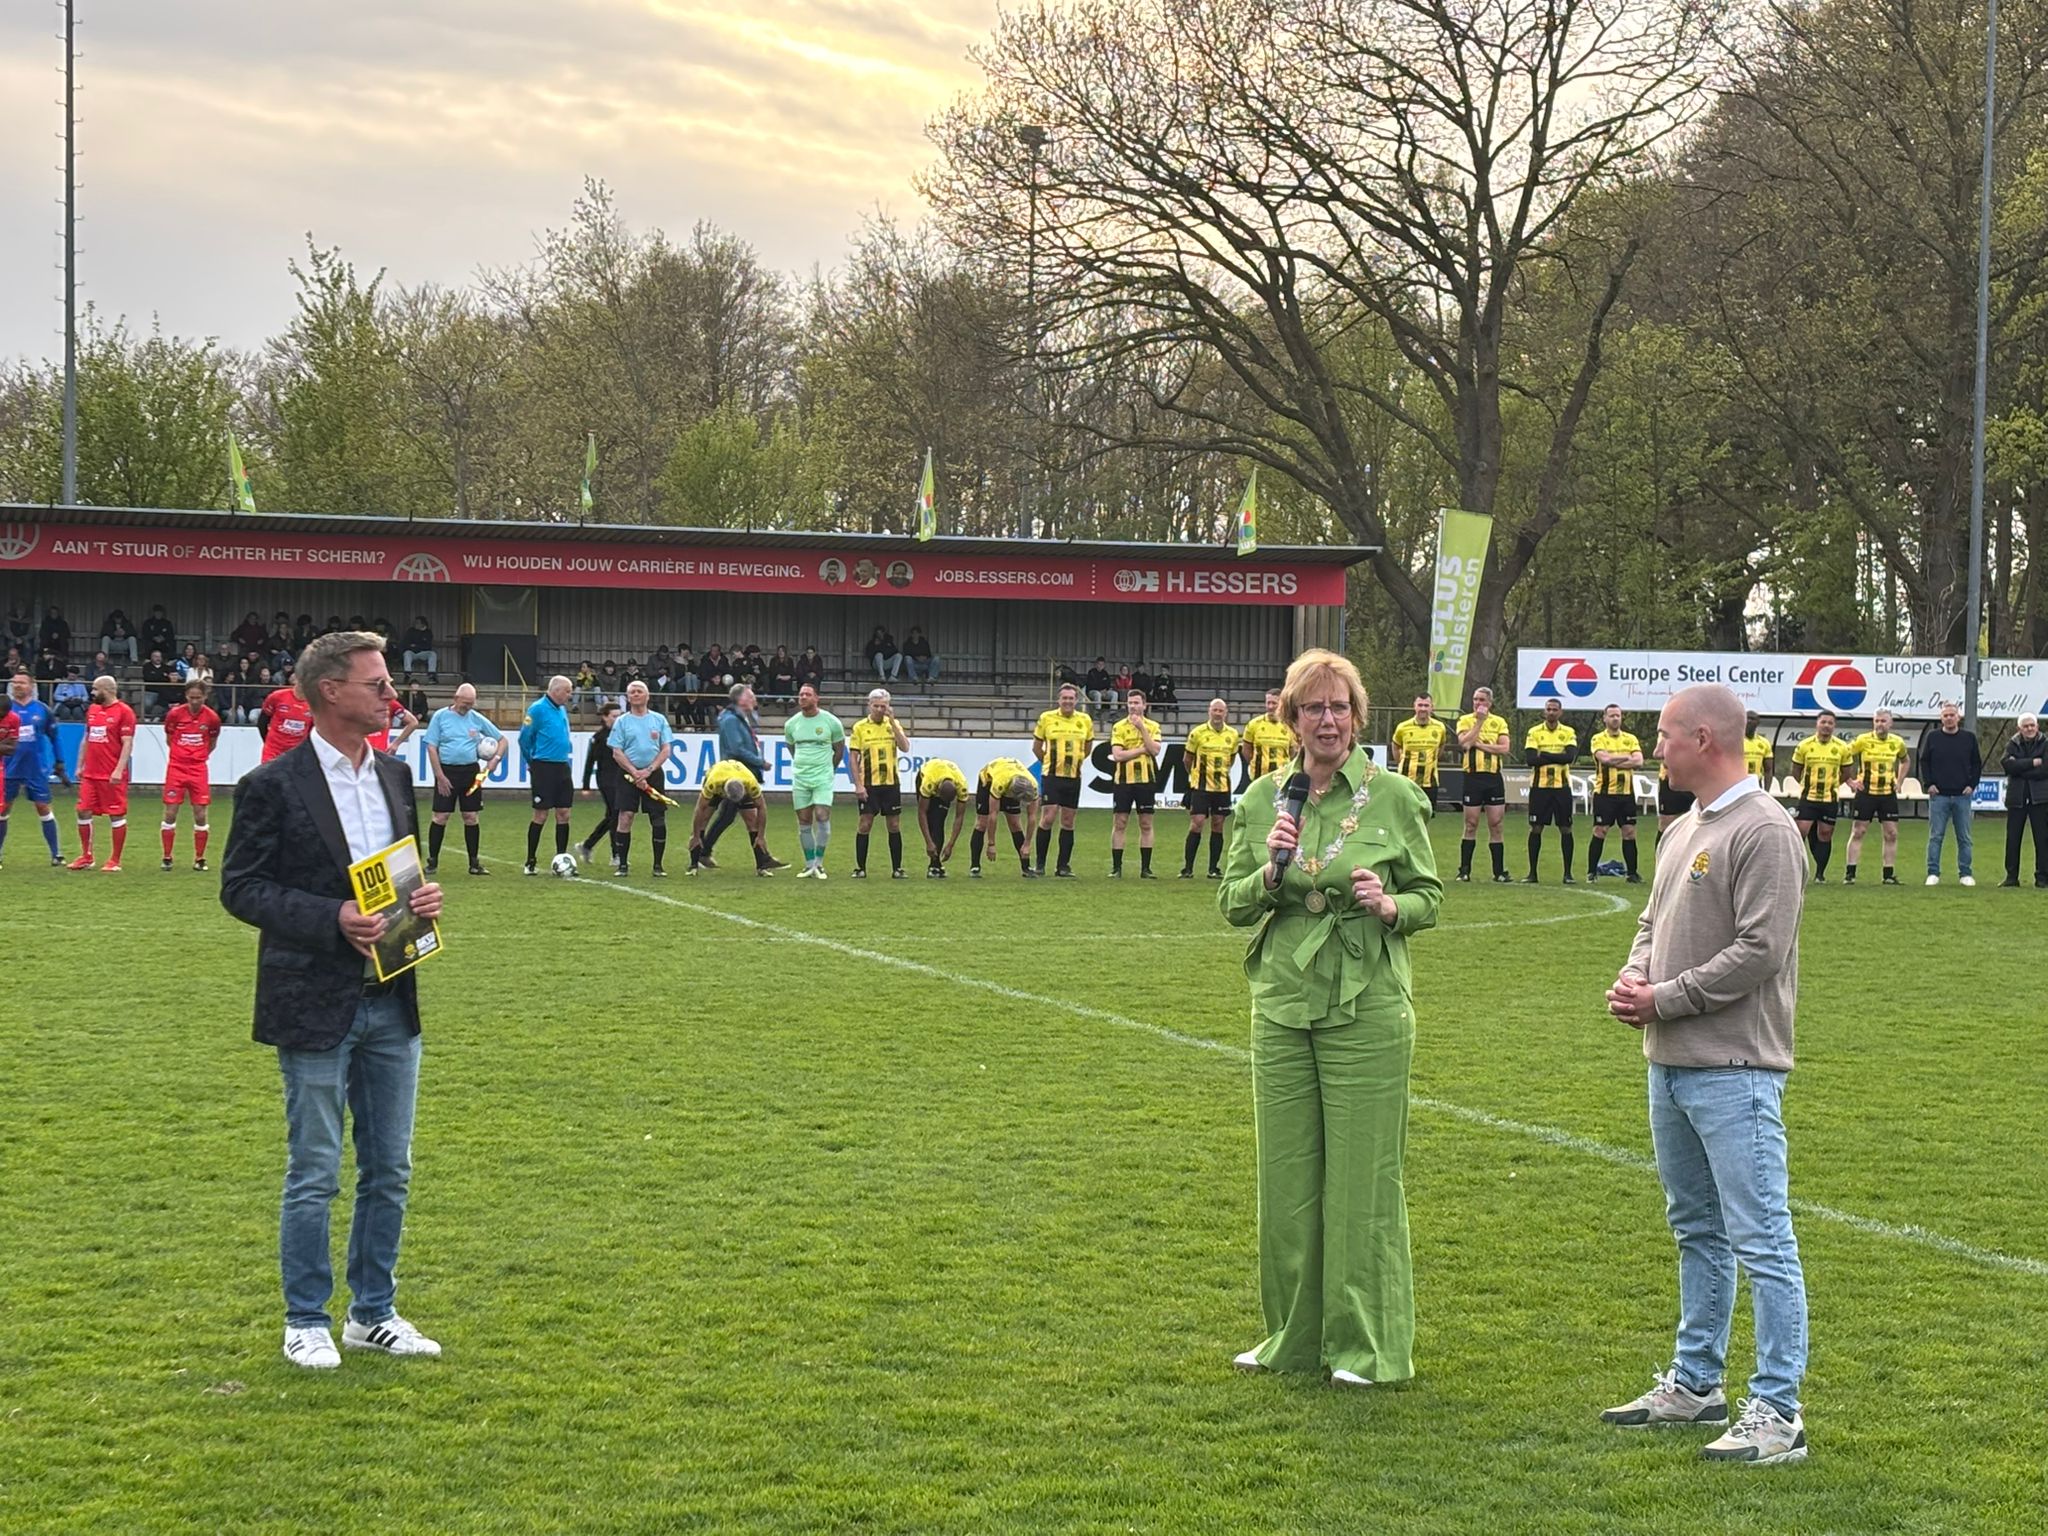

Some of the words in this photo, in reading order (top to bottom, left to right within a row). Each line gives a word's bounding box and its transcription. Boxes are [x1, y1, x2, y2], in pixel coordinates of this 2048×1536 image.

[52, 540, 89, 555] AAN
[93, 541, 109, 556] 'T
[112, 542, 169, 558] STUUR
[172, 544, 196, 559] OF
[199, 545, 267, 561] ACHTER
[270, 547, 303, 562] HET
[307, 548, 386, 564] SCHERM?
[463, 554, 492, 569] WIJ
[496, 556, 562, 571] HOUDEN
[566, 557, 613, 572] JOUW
[617, 558, 695, 575] CARRIÈRE
[699, 561, 714, 575] IN
[718, 562, 806, 578] BEWEGING.
[935, 569, 1074, 586] JOBS.ESSERS.COM
[1166, 570, 1298, 595] H.ESSERS
[1433, 555, 1463, 645] PLUS
[1444, 558, 1481, 675] Halsteren
[1609, 663, 1670, 685] Europe
[1677, 664, 1721, 683] Steel
[1728, 665, 1785, 684] Center
[1875, 657, 1932, 678] Europe
[1990, 662, 2034, 677] enter
[1878, 690, 1923, 708] Number
[1976, 692, 2029, 716] urope!!!
[356, 861, 388, 892] 100
